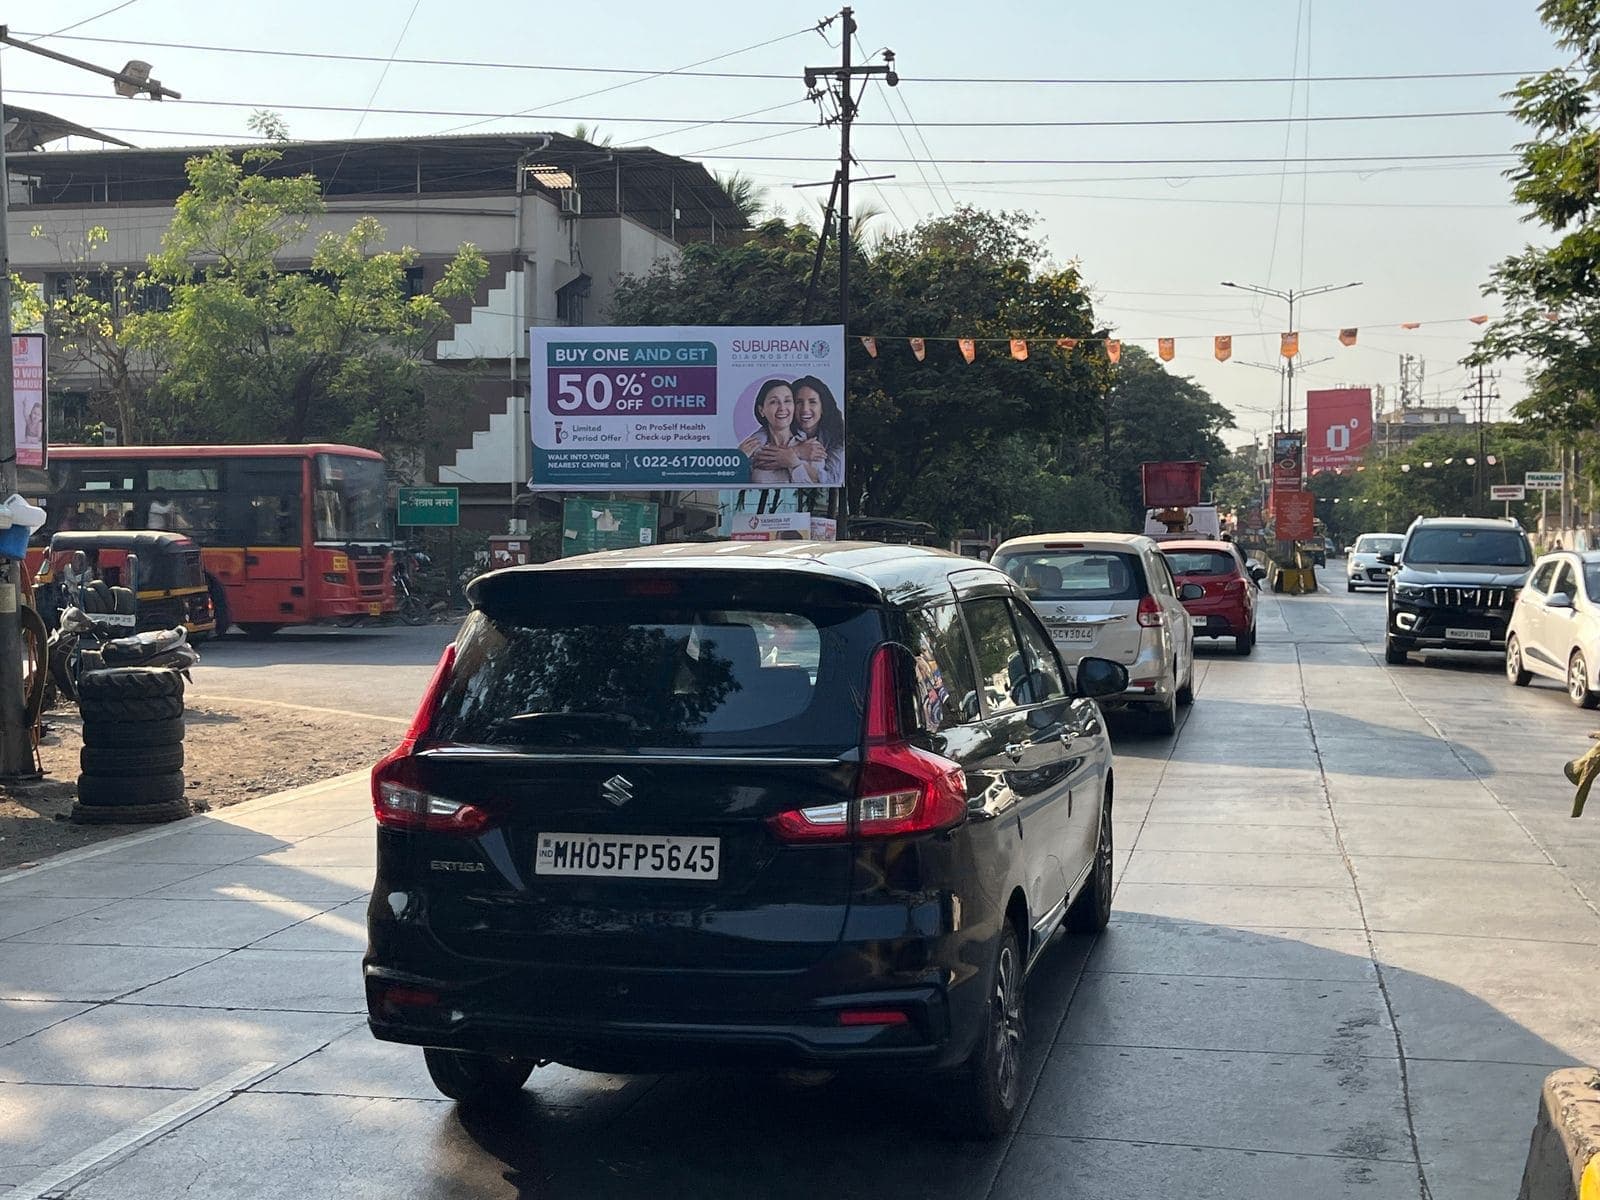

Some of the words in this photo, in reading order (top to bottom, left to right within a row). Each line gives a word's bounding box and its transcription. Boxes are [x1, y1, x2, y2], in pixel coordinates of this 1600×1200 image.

[732, 340, 809, 353] SUBURBAN
[555, 348, 588, 362] BUY
[592, 348, 629, 362] ONE
[634, 348, 671, 361] AND
[676, 348, 708, 361] GET
[651, 375, 677, 388] ON
[616, 399, 644, 410] OFF
[651, 395, 707, 408] OTHER
[572, 424, 602, 432] Limited
[679, 423, 706, 431] Health
[572, 434, 599, 442] Period
[600, 434, 622, 442] Offer
[635, 433, 672, 442] Check-up
[674, 433, 711, 442] Packages
[548, 461, 580, 469] NEAREST
[581, 461, 609, 469] CENTRE
[610, 461, 621, 469] OR
[642, 455, 740, 468] 022-61700000
[539, 849, 554, 858] IND
[553, 841, 715, 874] MH05FP5645
[431, 860, 486, 872] ERTIGA
